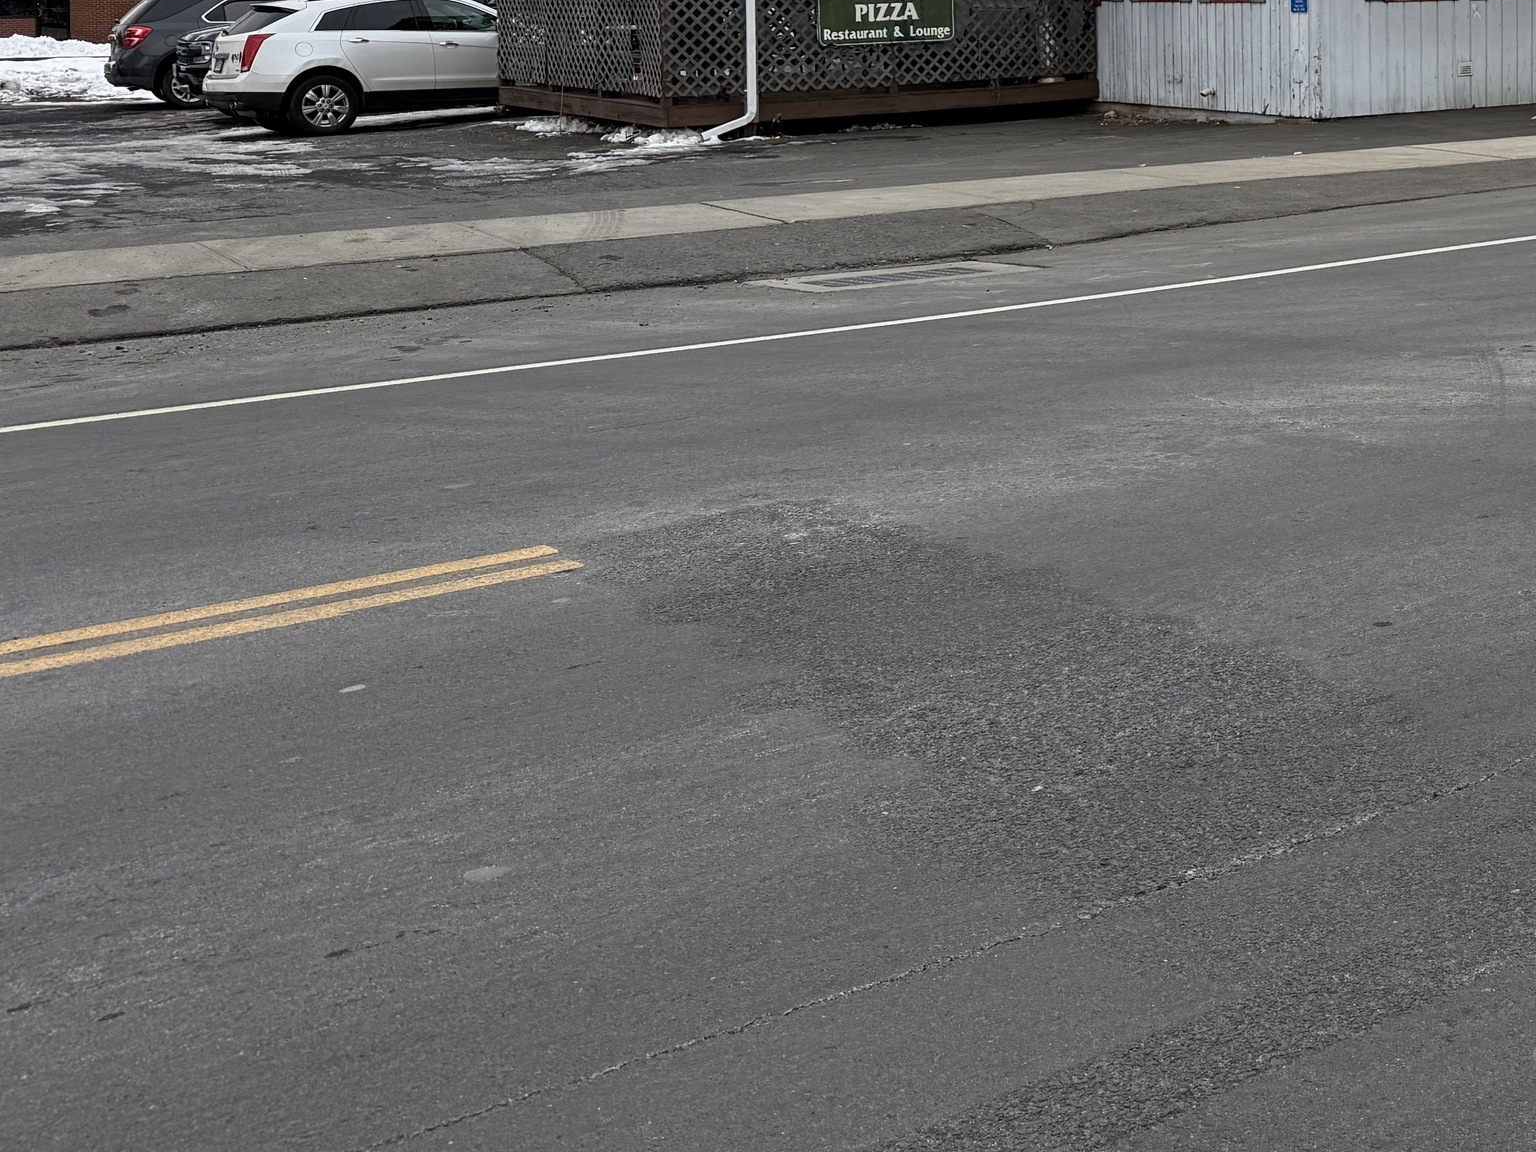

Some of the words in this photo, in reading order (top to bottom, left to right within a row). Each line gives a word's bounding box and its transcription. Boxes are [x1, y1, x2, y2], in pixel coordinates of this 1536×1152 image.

[855, 2, 919, 22] PIZZA
[823, 27, 887, 40] Restaurant
[893, 26, 904, 37] &
[910, 25, 950, 38] Lounge
